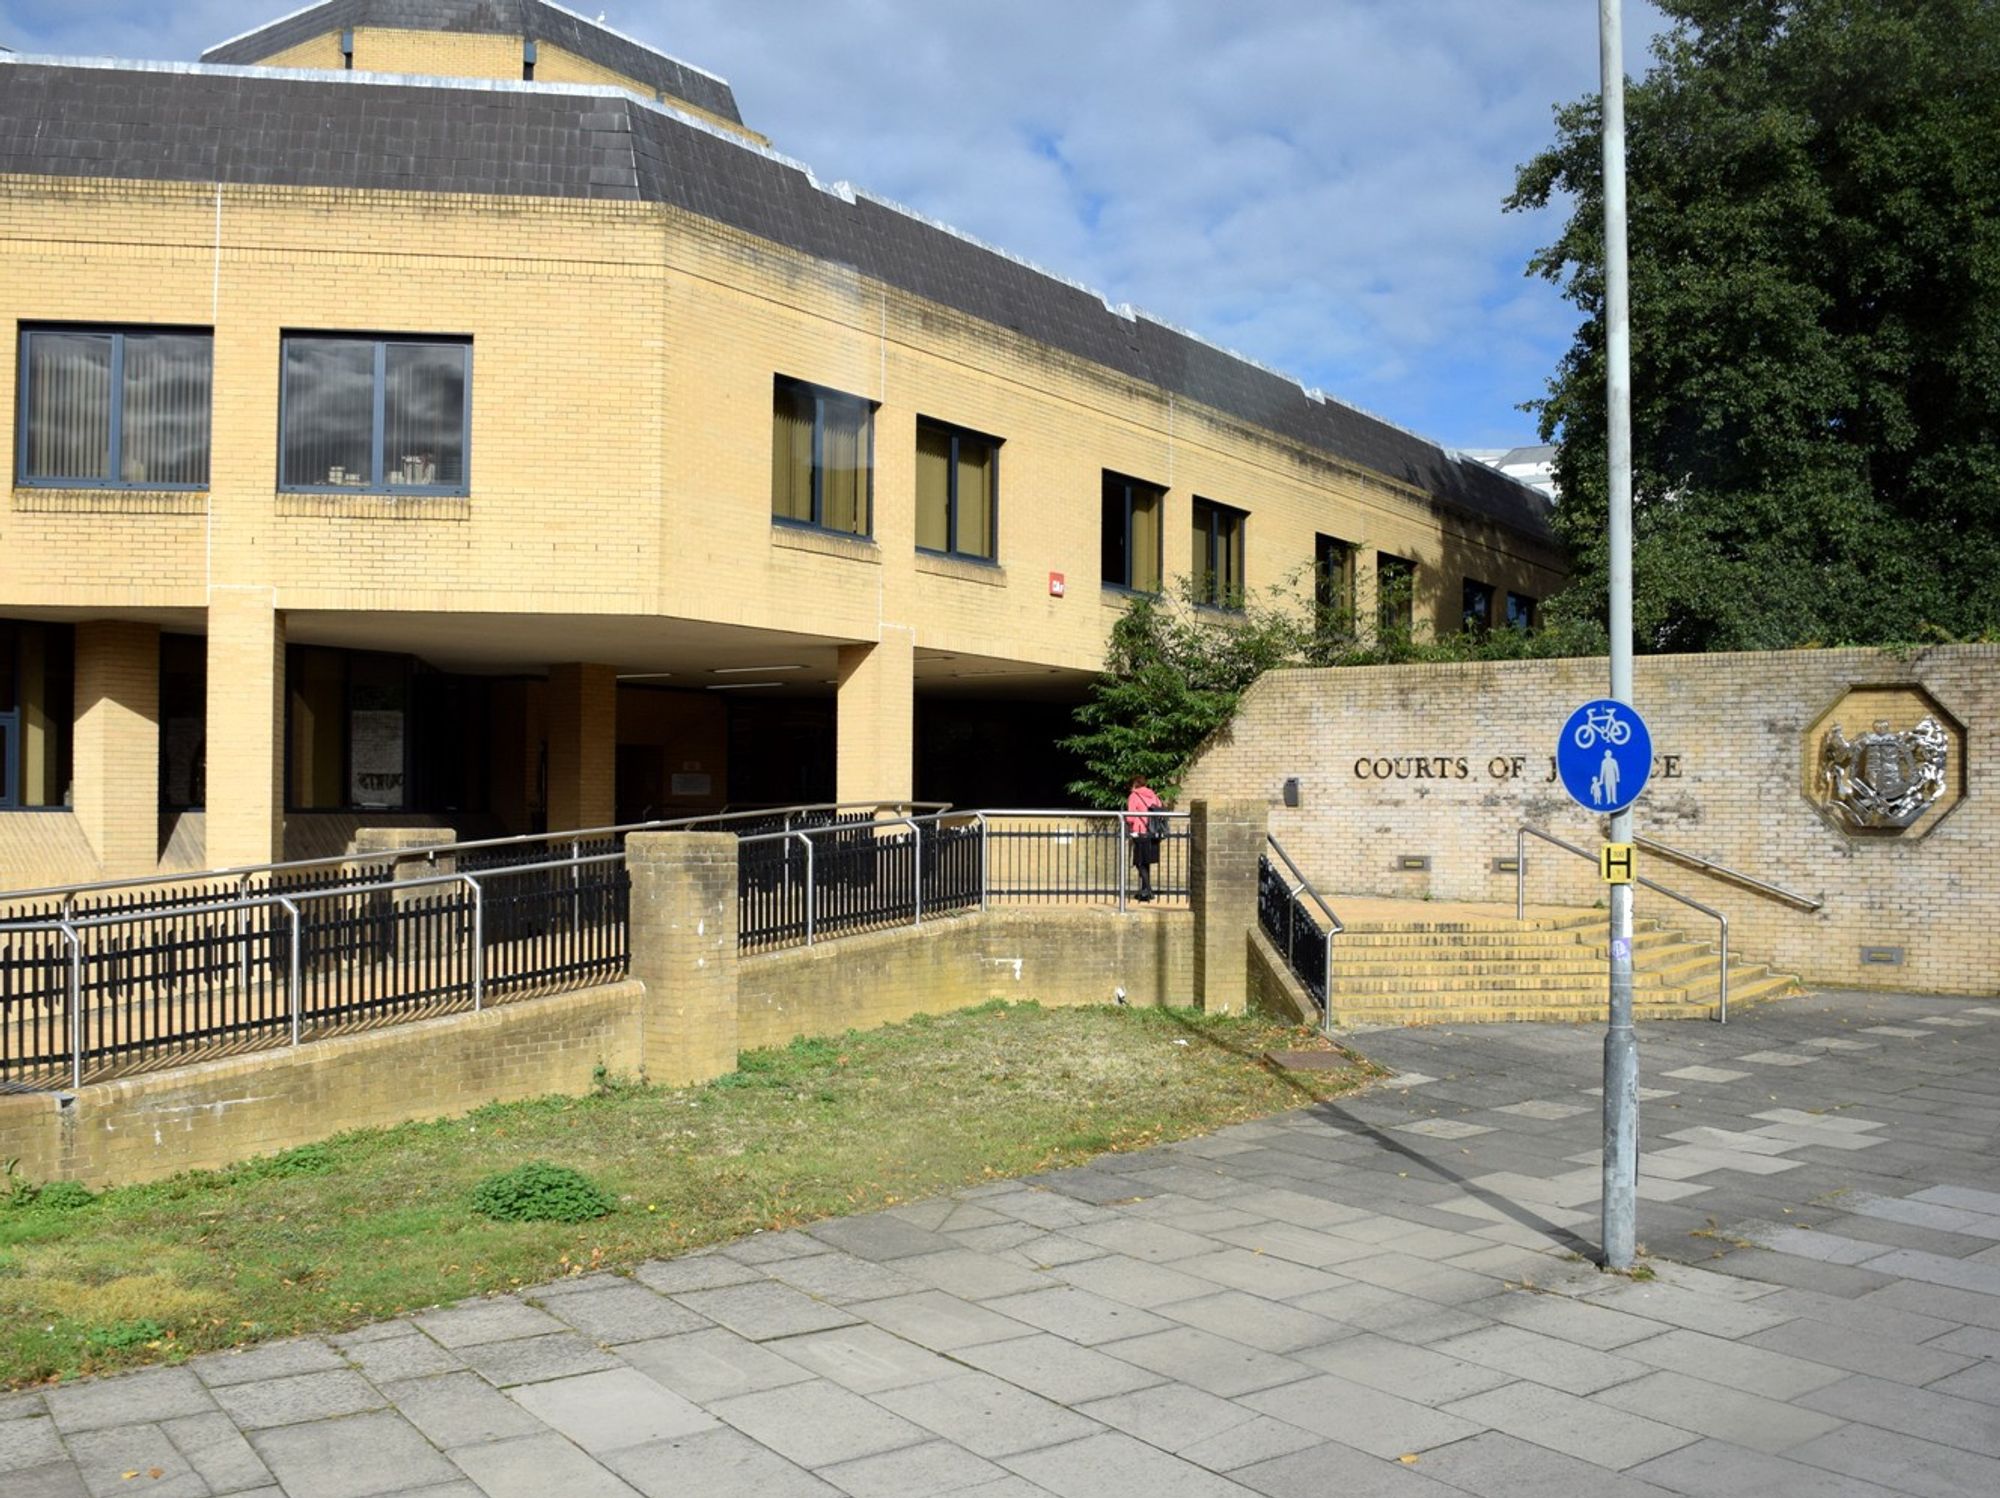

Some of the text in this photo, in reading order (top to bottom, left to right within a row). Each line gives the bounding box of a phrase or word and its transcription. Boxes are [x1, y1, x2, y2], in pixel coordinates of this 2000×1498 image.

[1354, 757, 1469, 780] COURTS
[1488, 756, 1526, 779] OF
[1606, 847, 1631, 879] H
